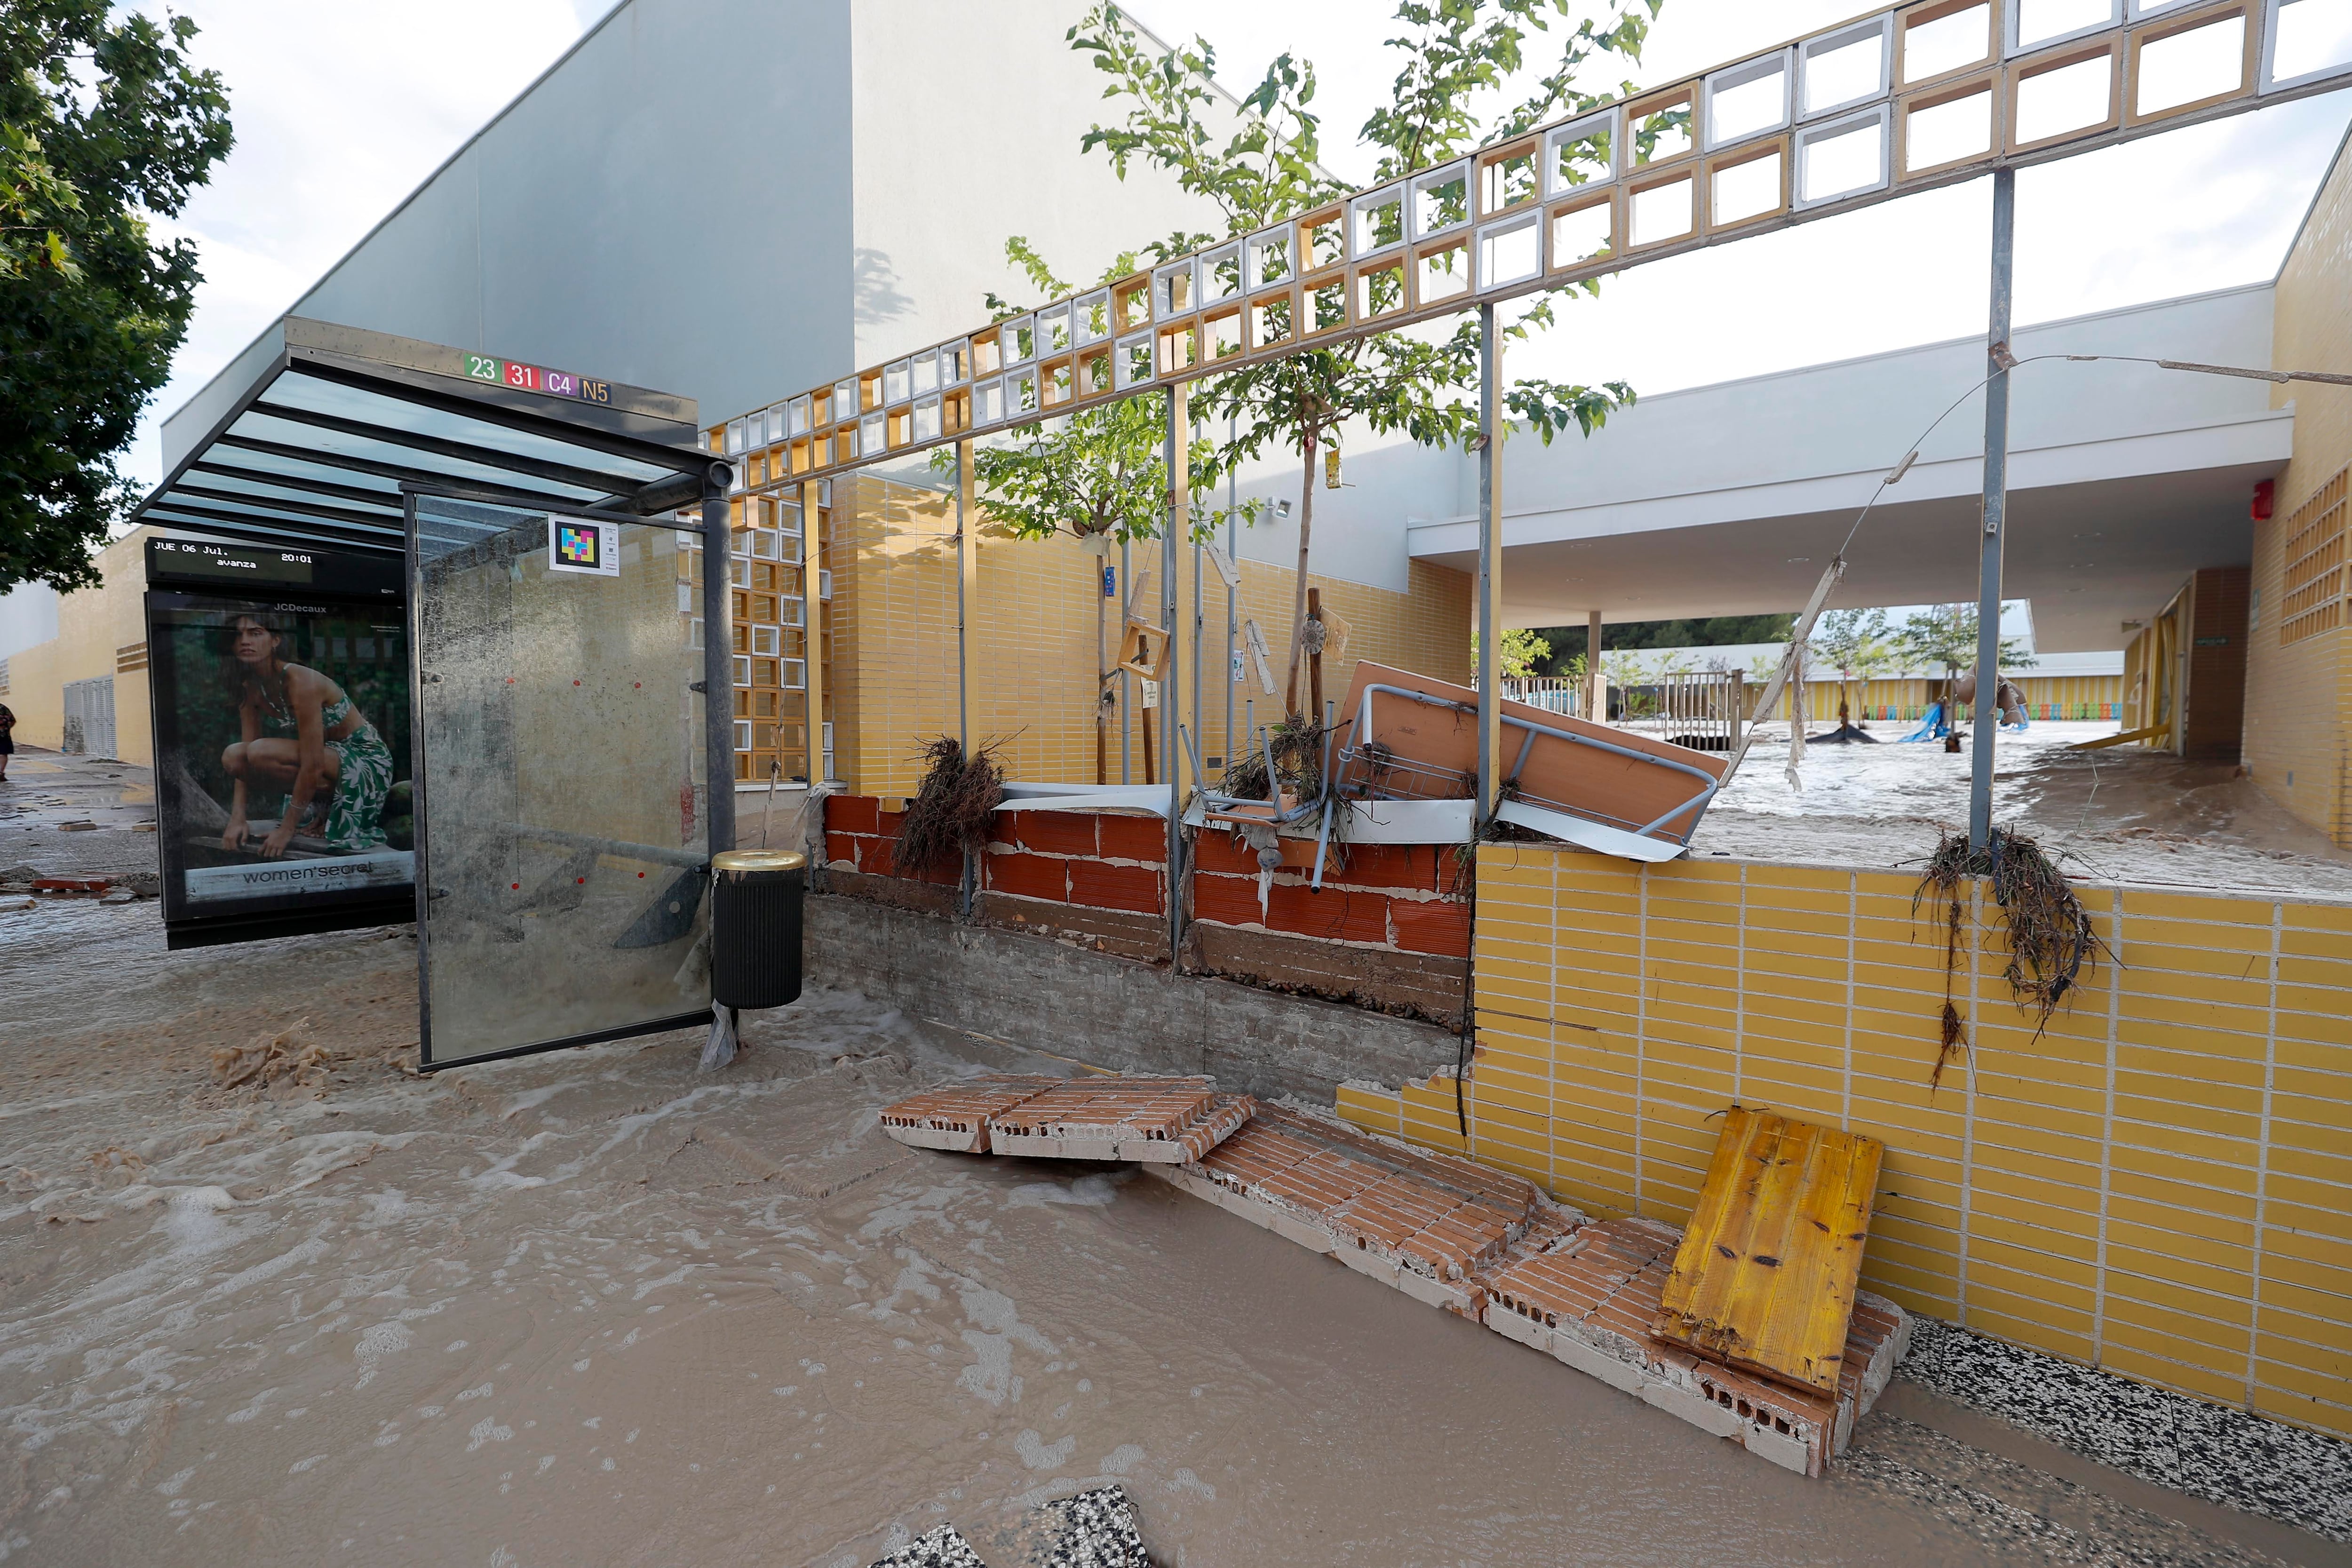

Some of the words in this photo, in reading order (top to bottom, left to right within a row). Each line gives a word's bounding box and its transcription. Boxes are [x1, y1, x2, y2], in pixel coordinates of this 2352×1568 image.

[470, 356, 495, 379] 23
[511, 365, 532, 387] 31
[548, 373, 571, 394] C4
[583, 380, 608, 402] N5
[154, 541, 176, 551] JUE
[182, 544, 197, 553] 06
[202, 546, 228, 556] Jul.
[281, 553, 312, 564] 20:01
[216, 559, 257, 569] avanza
[274, 603, 326, 613] JCDecaux
[243, 861, 374, 884] women'secret
